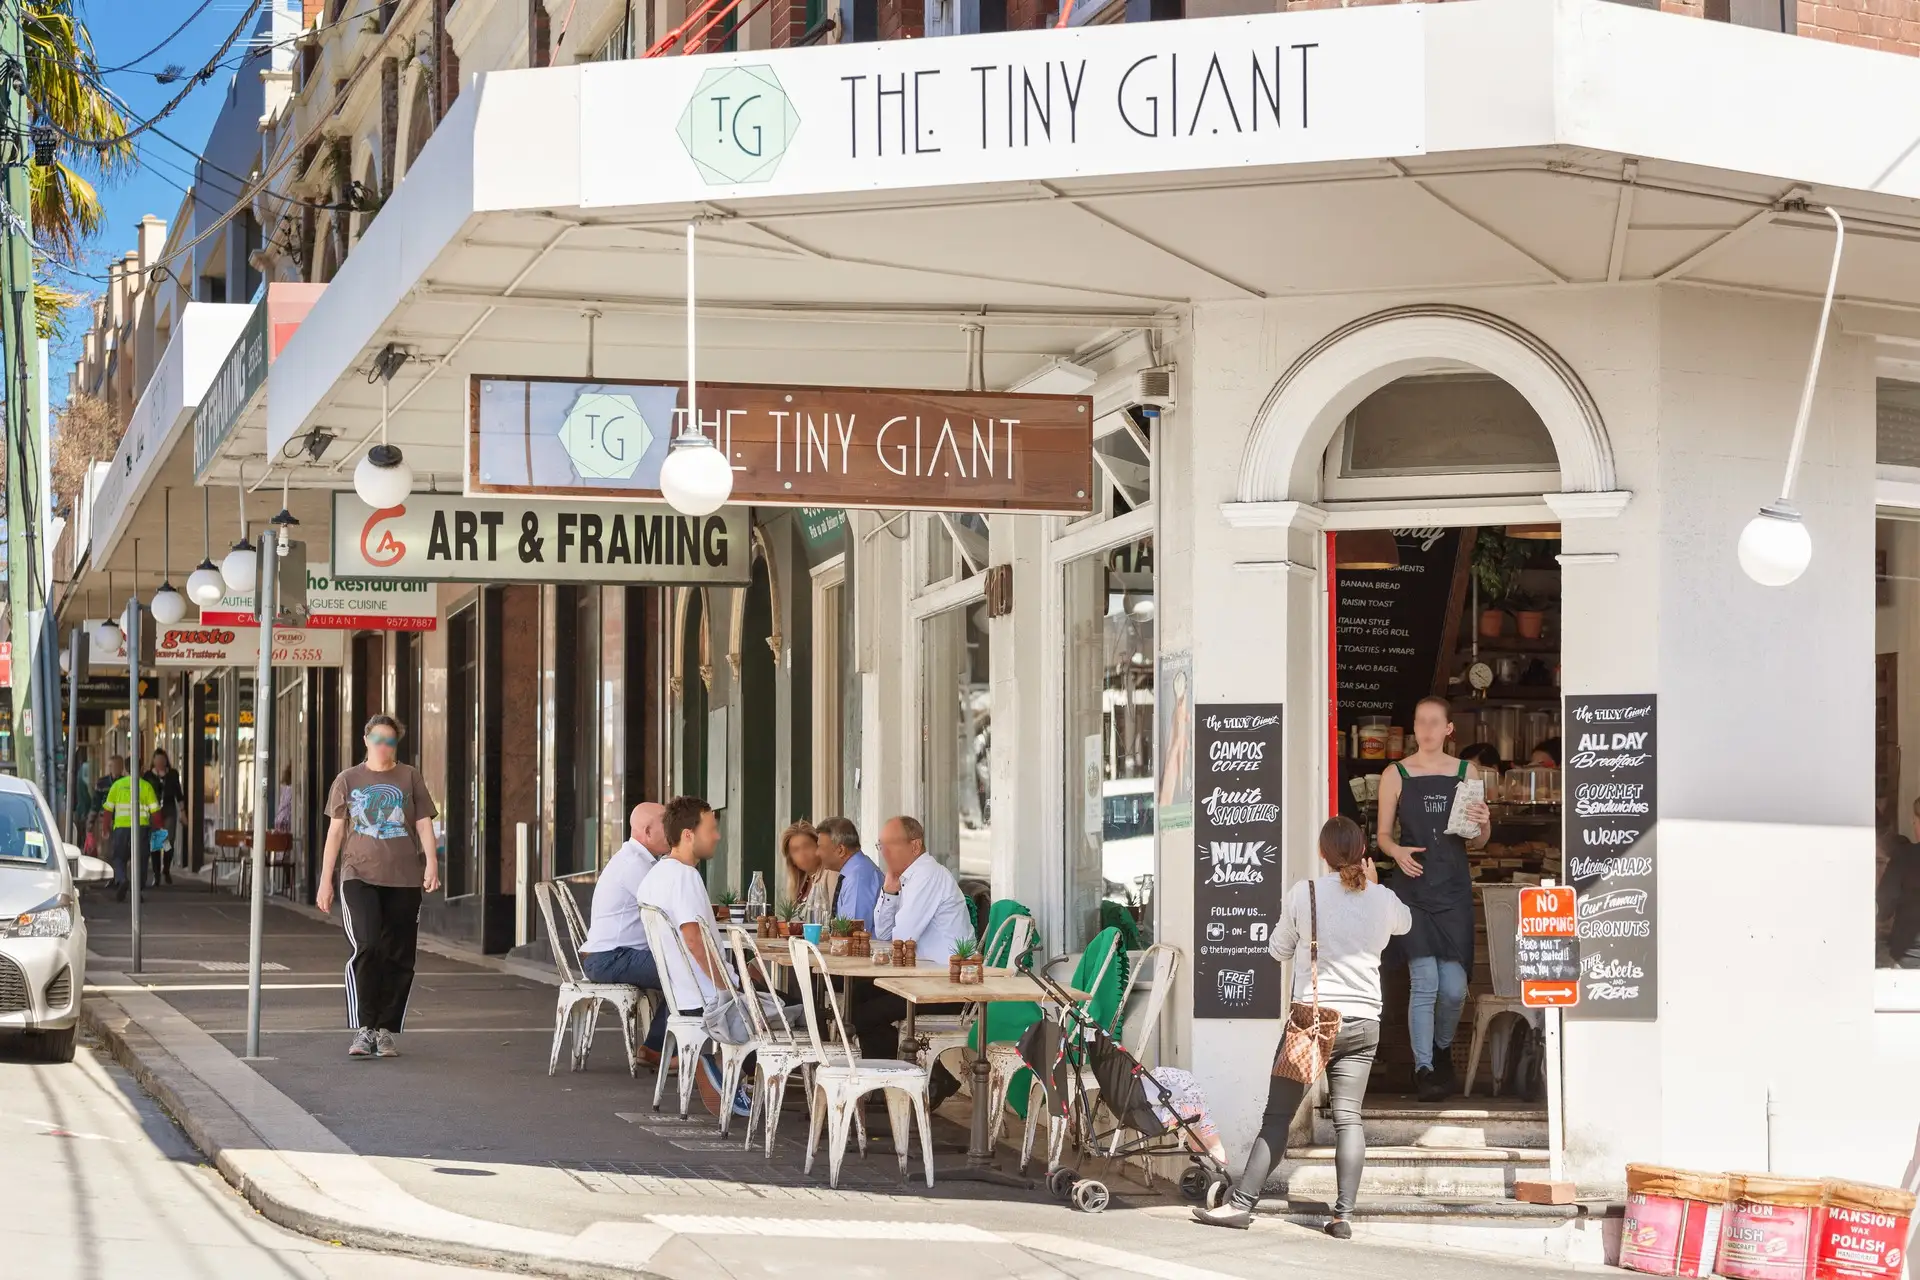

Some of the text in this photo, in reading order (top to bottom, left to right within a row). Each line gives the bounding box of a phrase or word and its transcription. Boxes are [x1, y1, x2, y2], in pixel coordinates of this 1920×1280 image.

[841, 43, 1319, 158] THE TINY GIANT
[768, 410, 856, 475] TINY
[876, 415, 1021, 480] GIANT
[426, 510, 729, 567] ART & FRAMING
[1340, 580, 1401, 590] BANANA BREAD
[221, 597, 253, 607] AUTHE
[348, 600, 388, 610] CUISINE
[1341, 598, 1395, 608] RAISIN TOAST
[307, 616, 357, 625] AURANT
[386, 617, 433, 628] 9572 7887
[1338, 616, 1390, 626] ITALIAN STYLE
[161, 629, 235, 649] gusto
[1390, 628, 1410, 637] ROLL
[186, 648, 226, 659] Trattoria
[292, 648, 323, 661] 5358
[1344, 645, 1380, 653] TOASTIES
[1388, 647, 1415, 655] WRAPS
[1373, 665, 1398, 673] BAGEL
[1355, 682, 1380, 690] SALAD
[1356, 701, 1394, 709] CRONUTS
[1594, 708, 1624, 720] TINY
[1223, 717, 1250, 729] TINY
[1578, 731, 1648, 751] ALL DAY
[1210, 740, 1266, 760] CAMPOS
[1212, 760, 1262, 772] COFFEE
[1570, 751, 1652, 772] Breakfast
[1575, 782, 1644, 801] GOURMET
[1201, 787, 1262, 816] fruit
[1424, 801, 1448, 813] GIANT
[1575, 799, 1649, 815] Sandwiches
[1210, 803, 1280, 826] SMOOTHIES
[1209, 840, 1266, 866] MILK
[1204, 863, 1264, 884] Shakes
[1601, 857, 1653, 880] SALADS
[1536, 894, 1558, 913] NO
[1603, 894, 1639, 910] Famous
[1211, 906, 1246, 917] FOLLOW
[1523, 917, 1574, 933] STOPPING
[1578, 920, 1651, 938] CRONUTS
[1589, 959, 1645, 979] Sweets
[1225, 971, 1251, 985] FREE
[1725, 1202, 1773, 1217] ANSION
[1829, 1206, 1897, 1229] MANSION
[1850, 1226, 1870, 1236] WAX
[1831, 1233, 1886, 1254] POLISH
